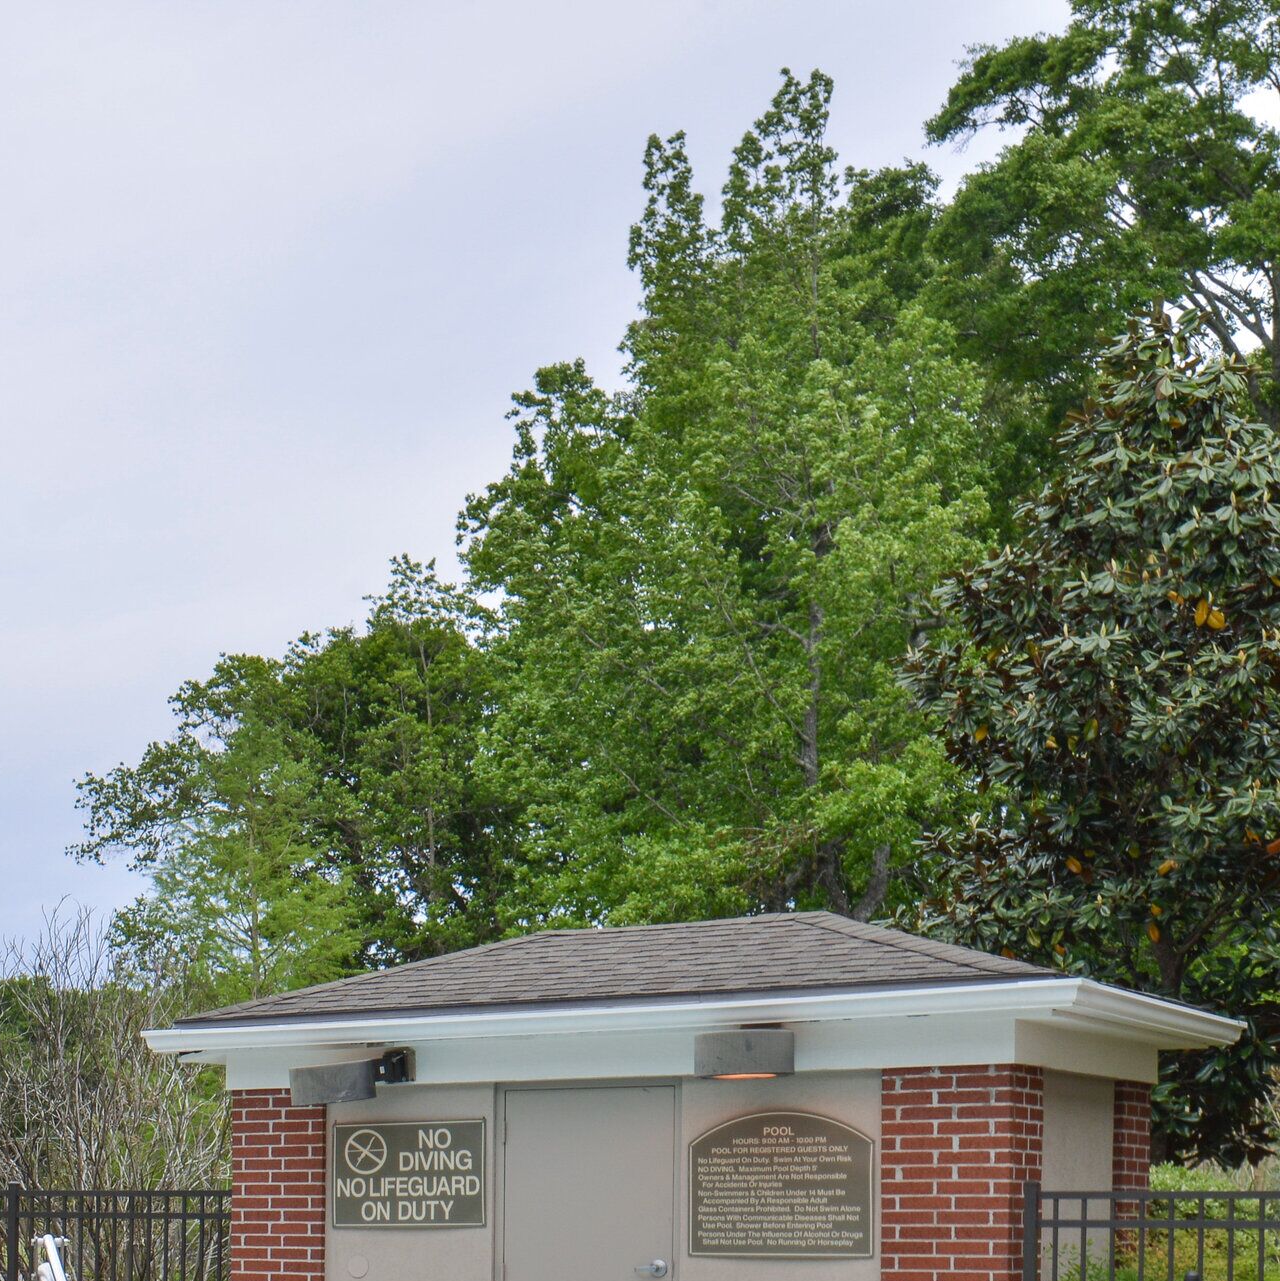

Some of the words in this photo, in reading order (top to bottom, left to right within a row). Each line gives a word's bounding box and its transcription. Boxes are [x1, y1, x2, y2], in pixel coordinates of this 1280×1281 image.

[418, 1128, 451, 1149] NO
[764, 1127, 794, 1136] POOL
[400, 1150, 472, 1171] DIVING
[337, 1178, 366, 1197] NO
[370, 1176, 480, 1196] LIFEGUARD
[758, 1181, 782, 1189] Injuries
[362, 1201, 390, 1221] ON
[398, 1201, 453, 1221] DUTY
[842, 1231, 863, 1239] Drugs
[778, 1239, 806, 1247] Running
